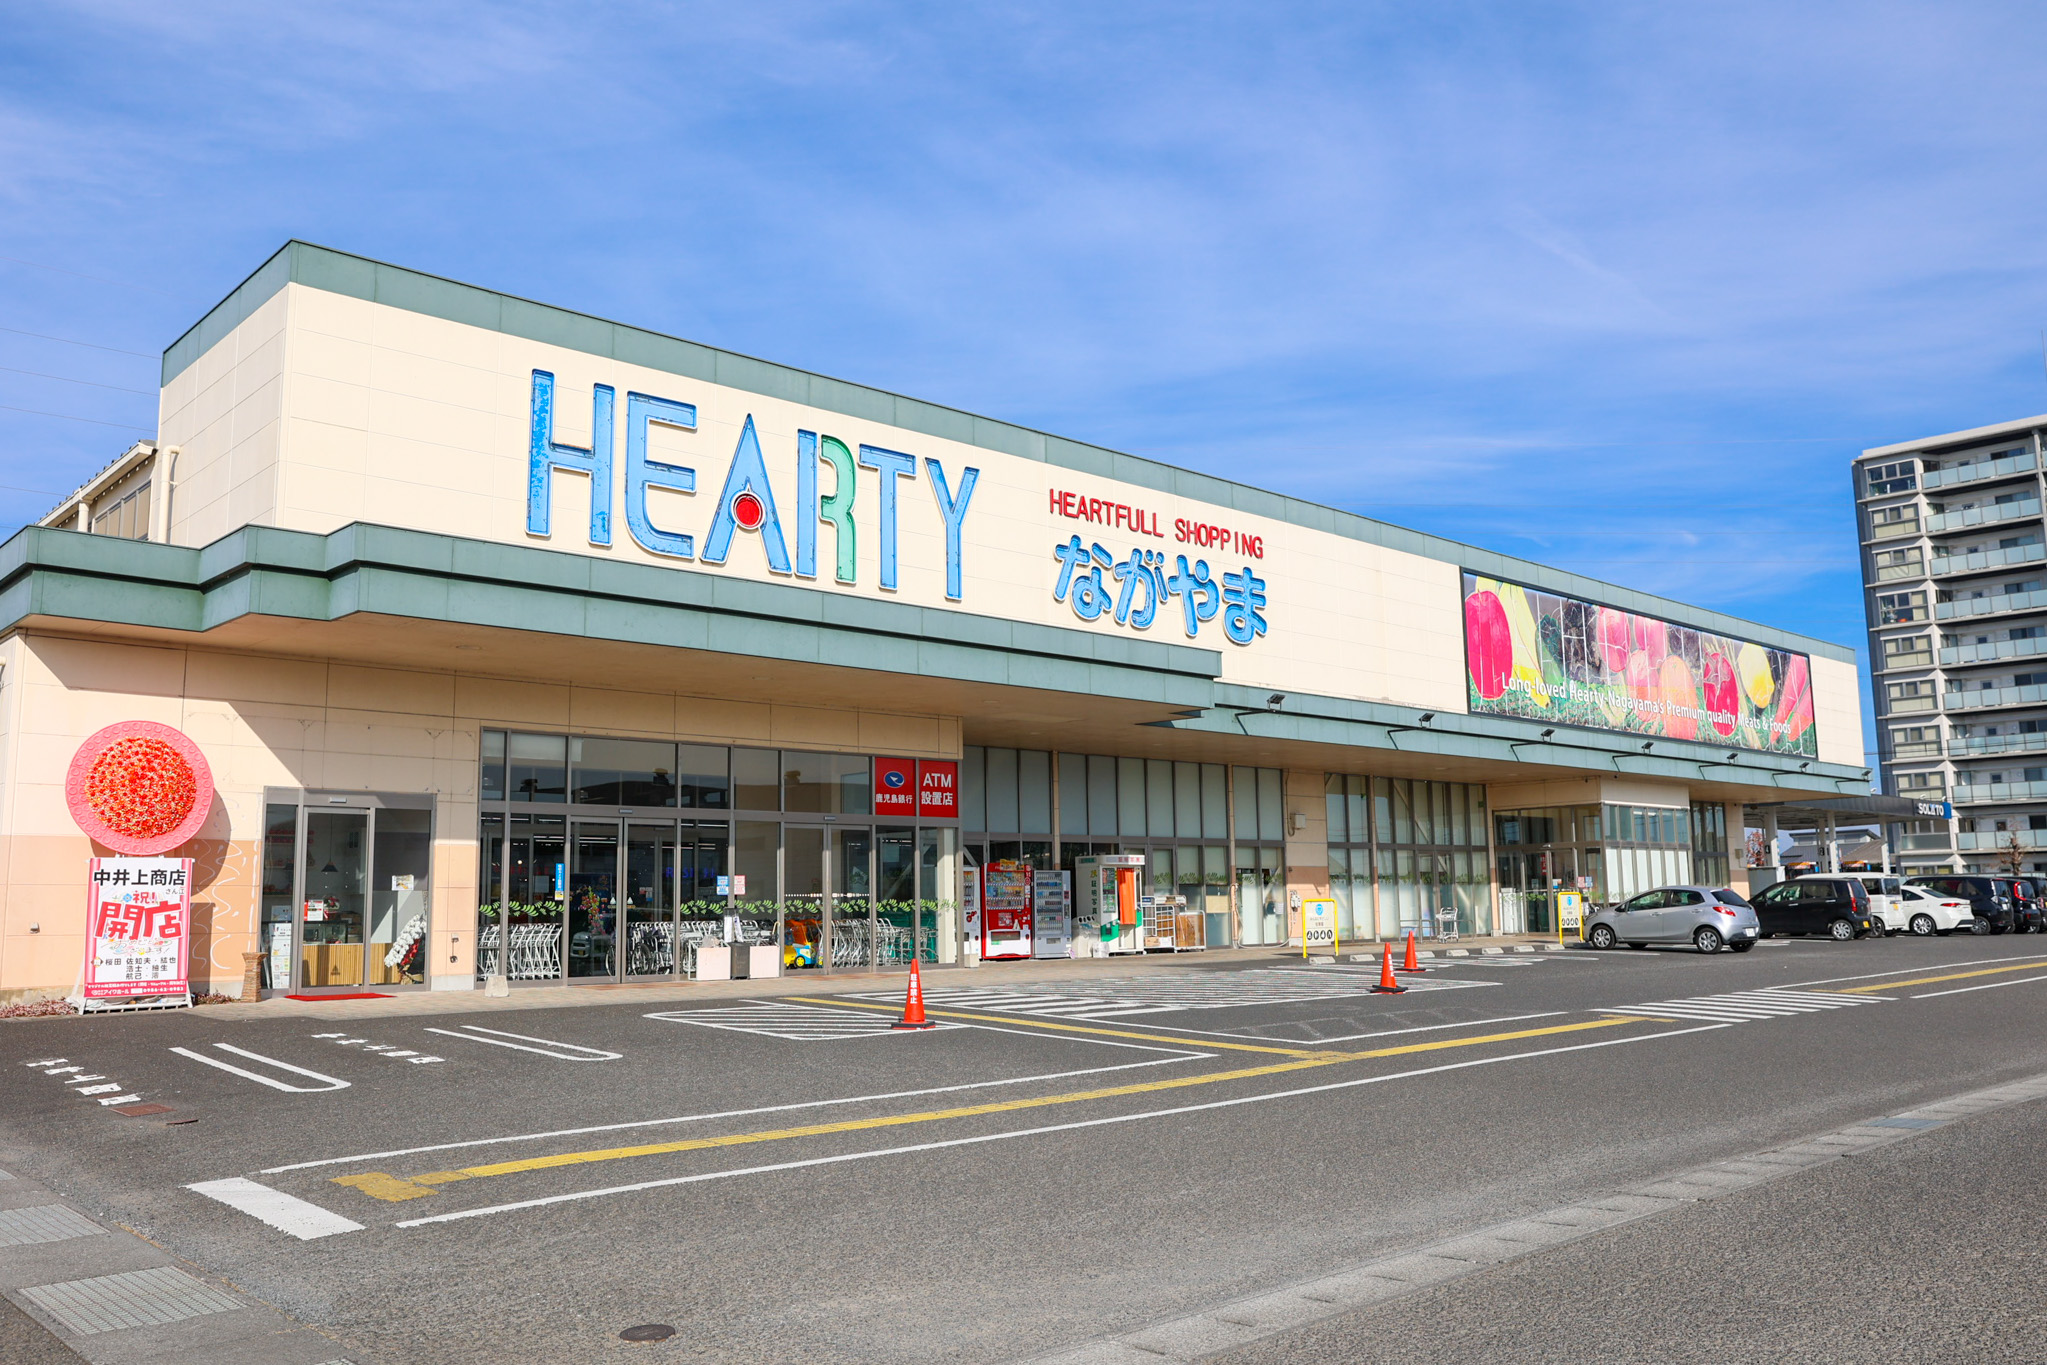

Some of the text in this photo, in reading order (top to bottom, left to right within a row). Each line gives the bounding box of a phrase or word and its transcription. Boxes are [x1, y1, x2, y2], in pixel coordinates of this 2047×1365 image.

[525, 368, 980, 601] HEARTY
[1050, 488, 1264, 559] HEARTFULL SHOPPING
[1054, 534, 1269, 646] ながやま
[1502, 672, 1792, 734] Long-loved Hearty-Nagayama's Premium quality Meats & Foods
[876, 793, 913, 804] 鹿児島銀行
[921, 791, 954, 806] 設置店
[923, 773, 952, 788] ATM
[94, 869, 186, 886] 中井上商店
[95, 900, 182, 940] 開店
